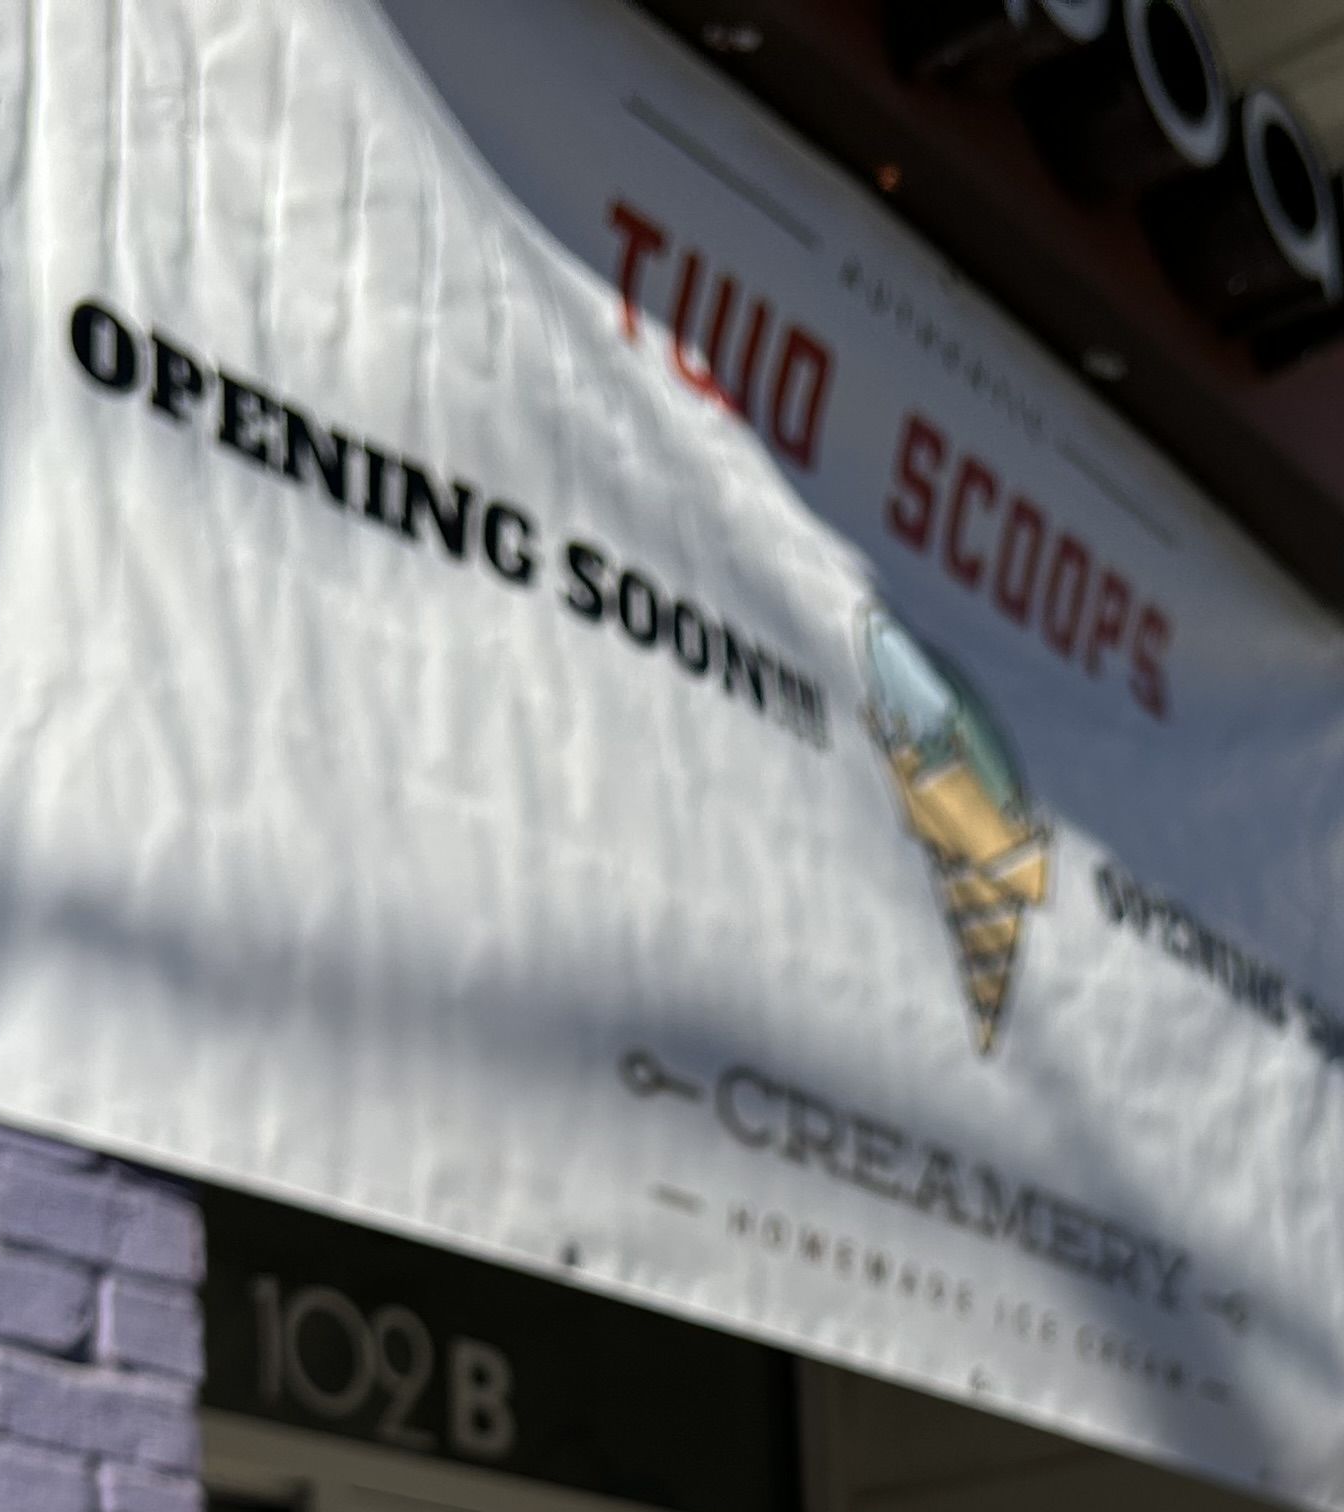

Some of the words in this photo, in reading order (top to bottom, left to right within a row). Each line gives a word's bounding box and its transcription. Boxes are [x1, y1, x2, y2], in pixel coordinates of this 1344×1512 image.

[68, 300, 540, 588] OPENING
[604, 196, 836, 472] TWO
[884, 408, 1178, 722] SCOOPS
[710, 1062, 1192, 1314] CREAMERY
[256, 1275, 440, 1450] 102
[448, 1335, 518, 1460] B
